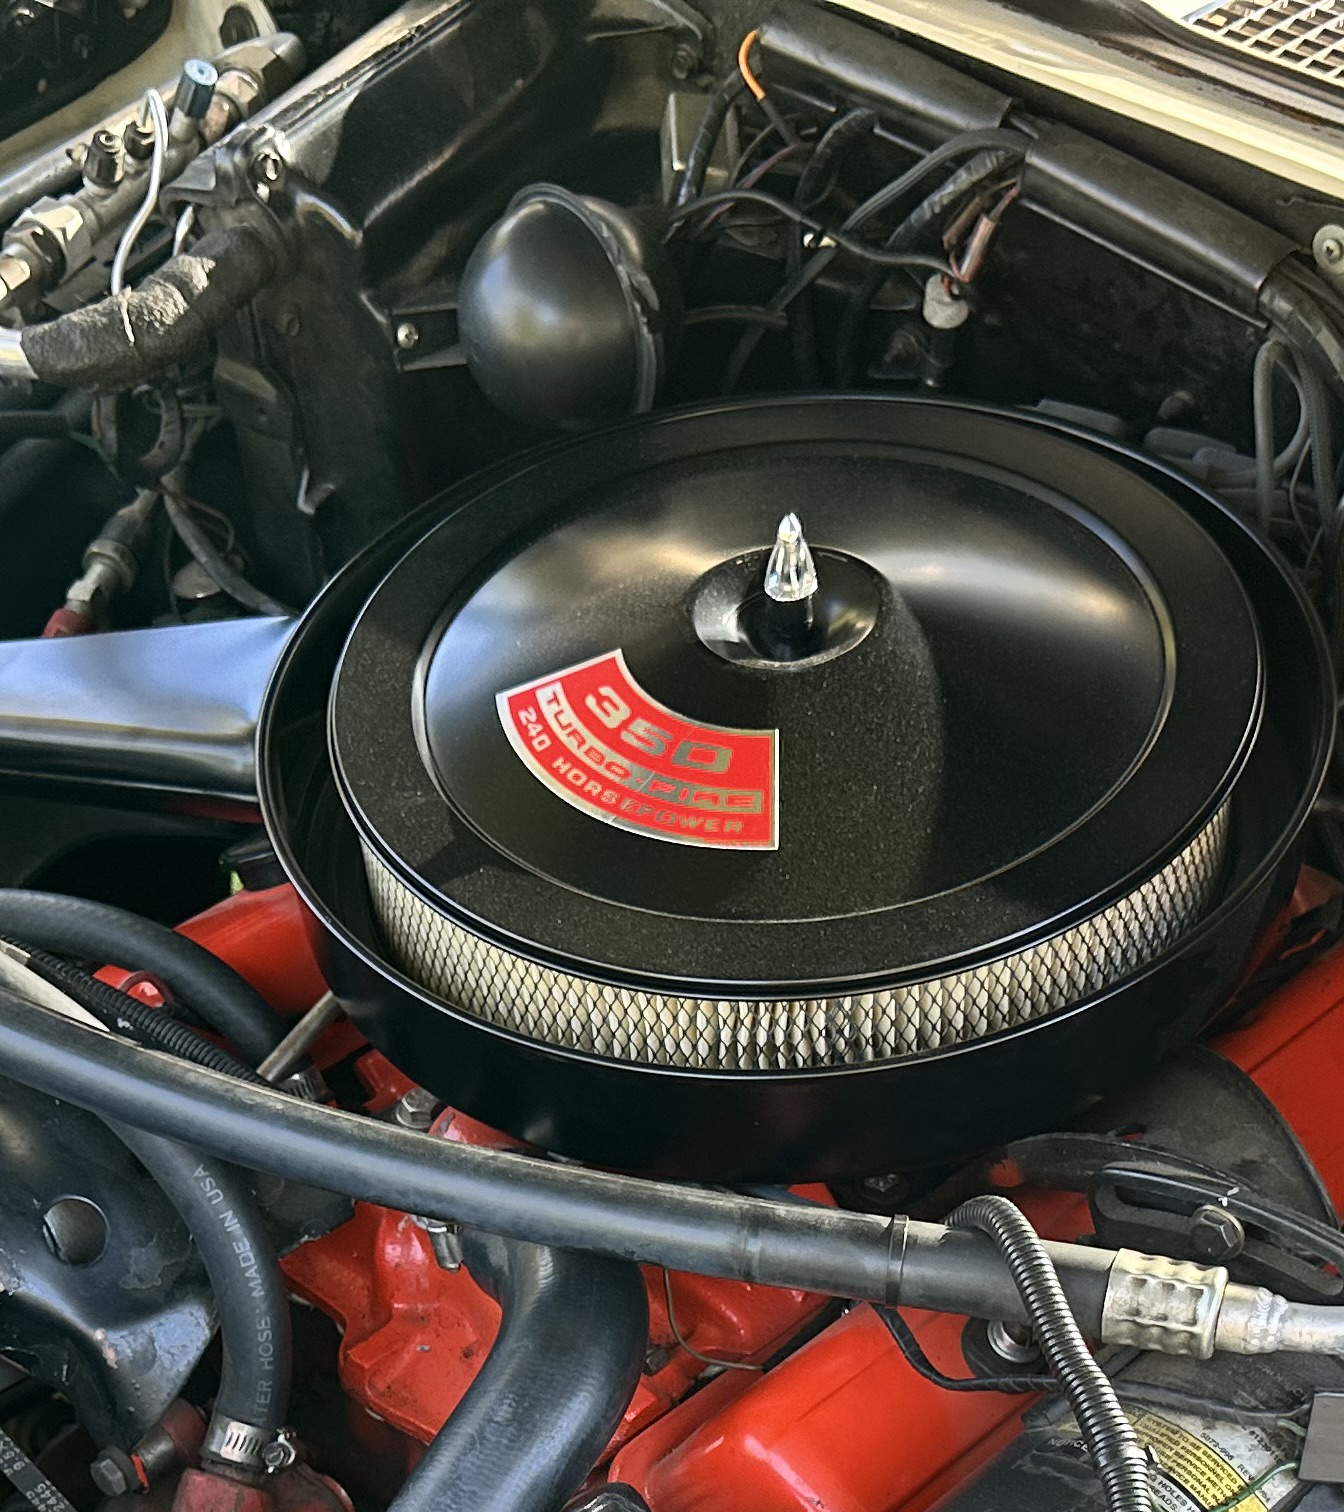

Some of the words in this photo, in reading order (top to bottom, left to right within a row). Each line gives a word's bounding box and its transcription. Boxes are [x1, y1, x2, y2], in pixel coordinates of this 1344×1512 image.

[585, 685, 733, 774] 350
[517, 706, 552, 752] 240
[551, 755, 744, 834] HORSEPOWER
[193, 1162, 224, 1205] USA
[219, 1210, 241, 1233] IN
[233, 1236, 265, 1298] MADE
[1156, 1478, 1189, 1507] HOLES
